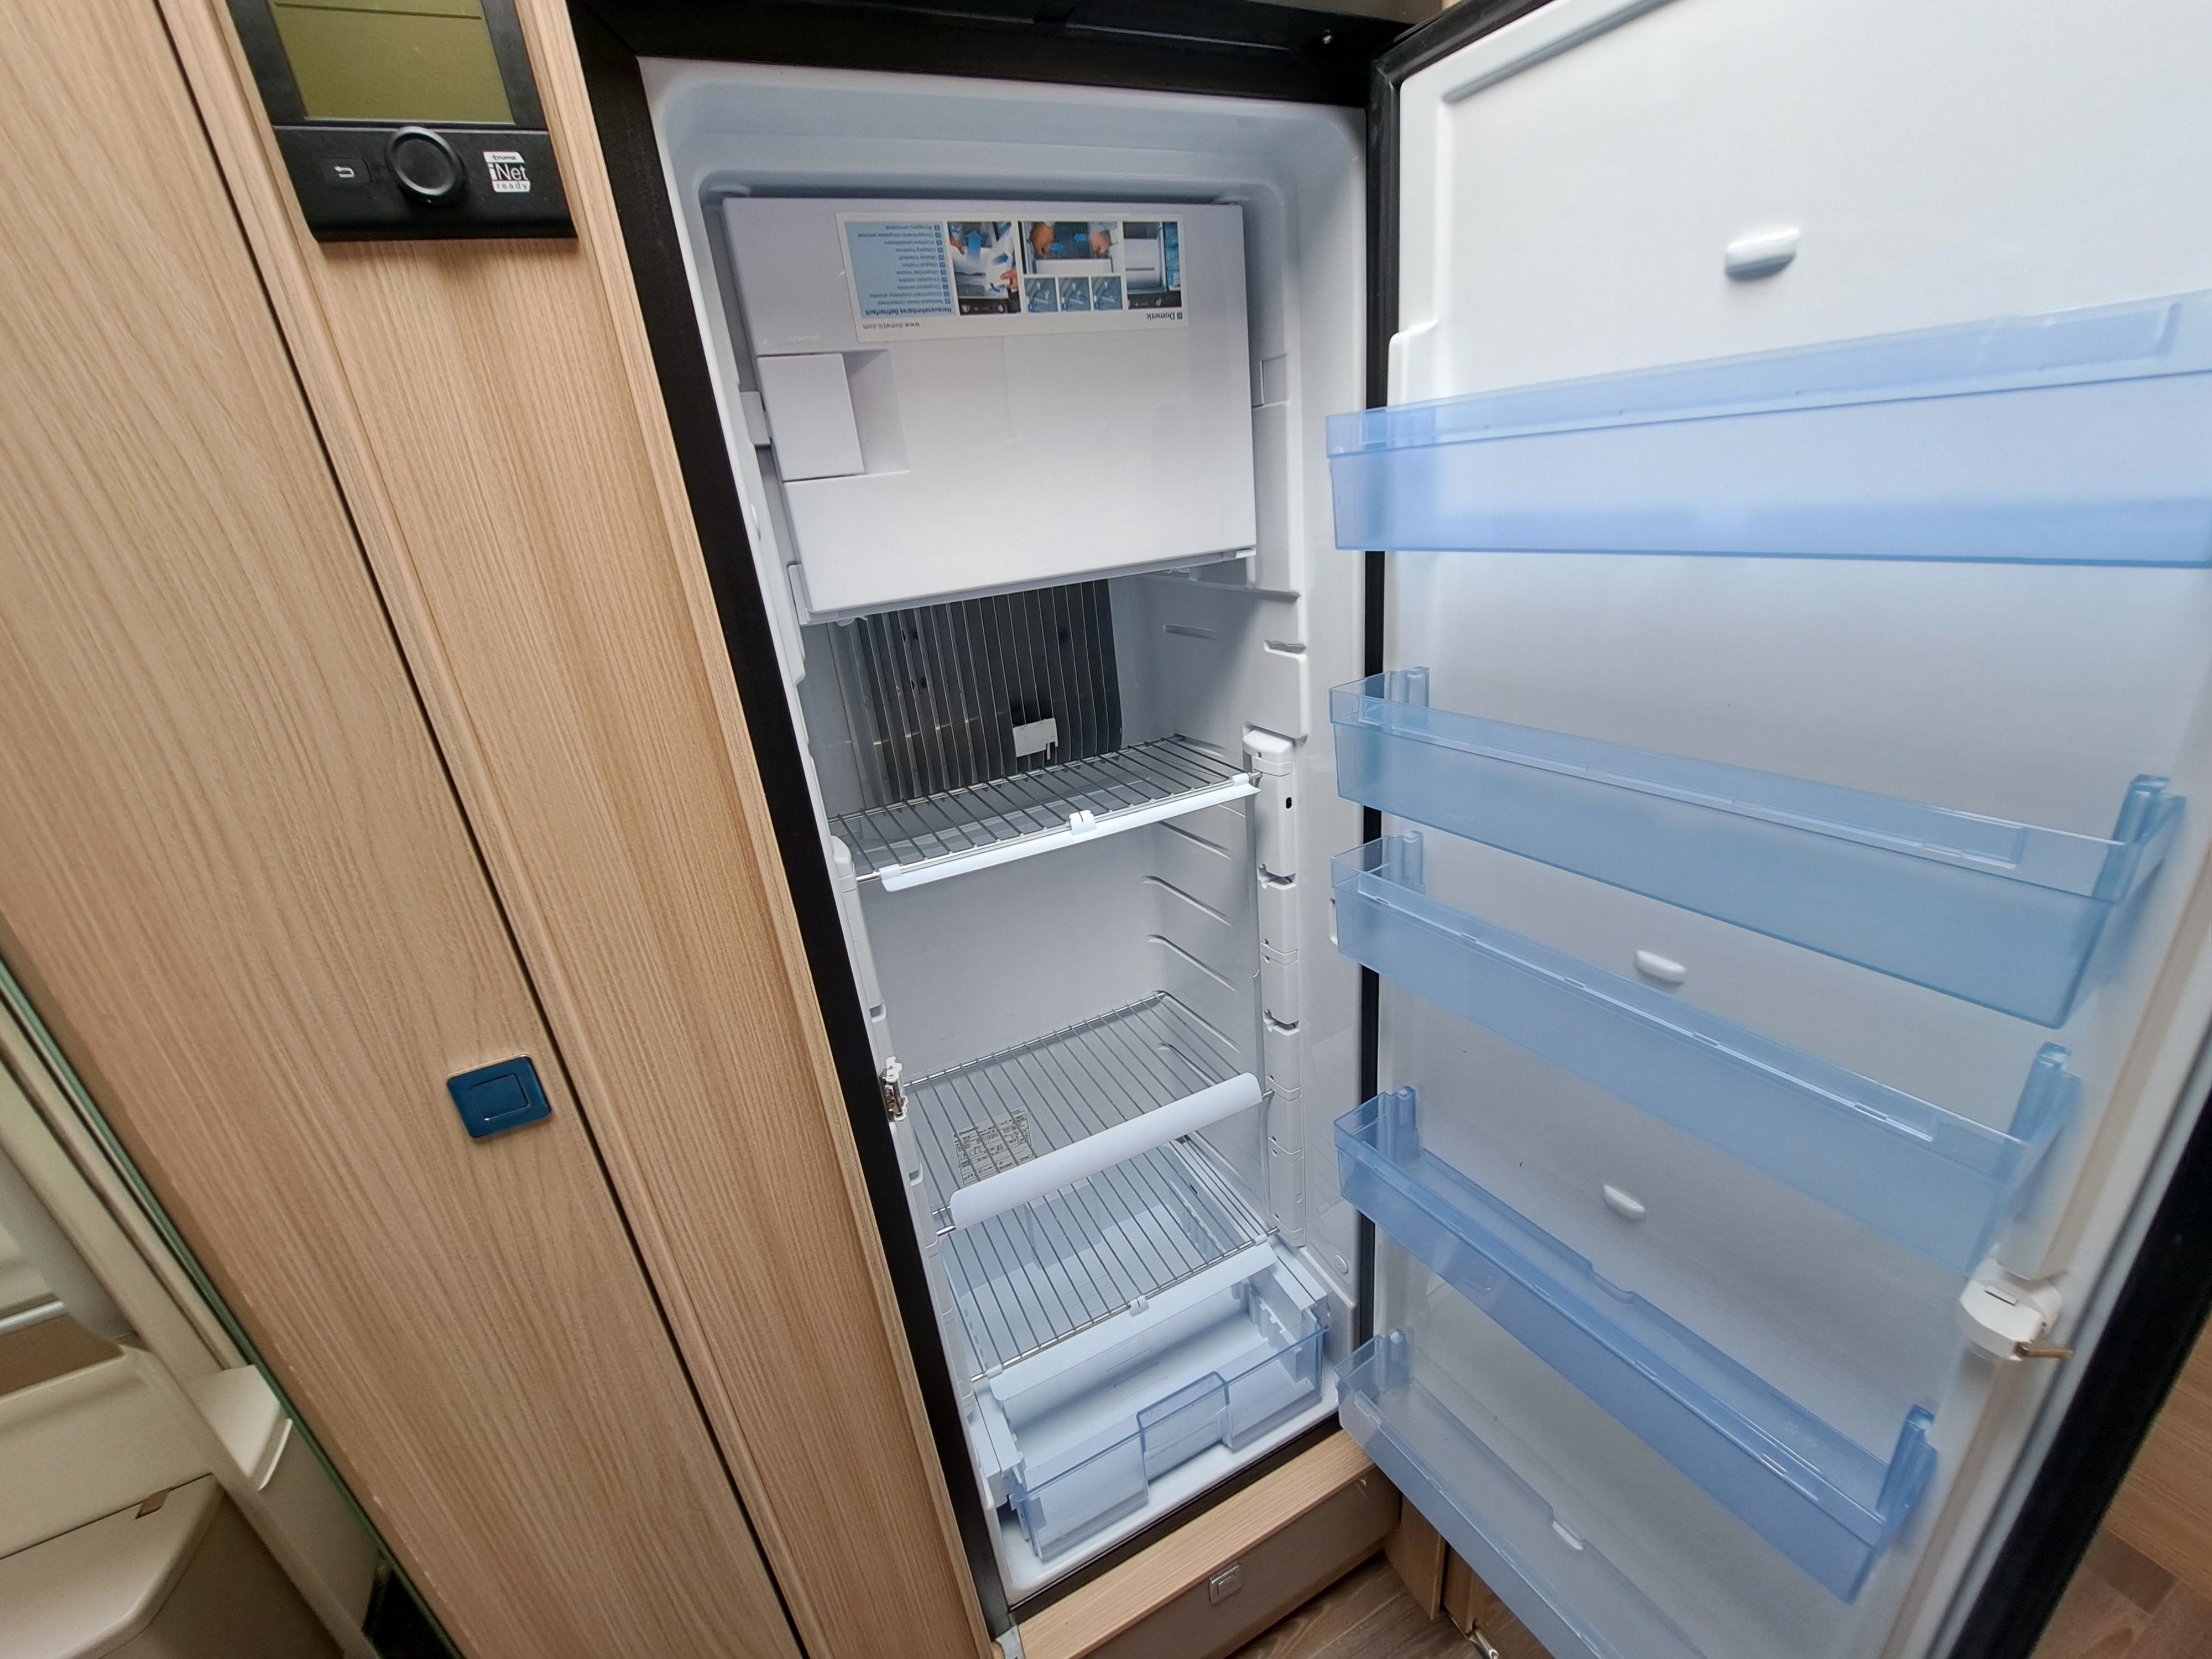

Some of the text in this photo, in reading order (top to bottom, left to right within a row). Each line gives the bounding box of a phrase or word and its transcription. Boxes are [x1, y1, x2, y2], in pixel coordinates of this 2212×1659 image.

[487, 163, 529, 181] iNet
[496, 181, 528, 190] ready
[1145, 312, 1176, 321] Dometic
[862, 321, 921, 330] www.dometic.com
